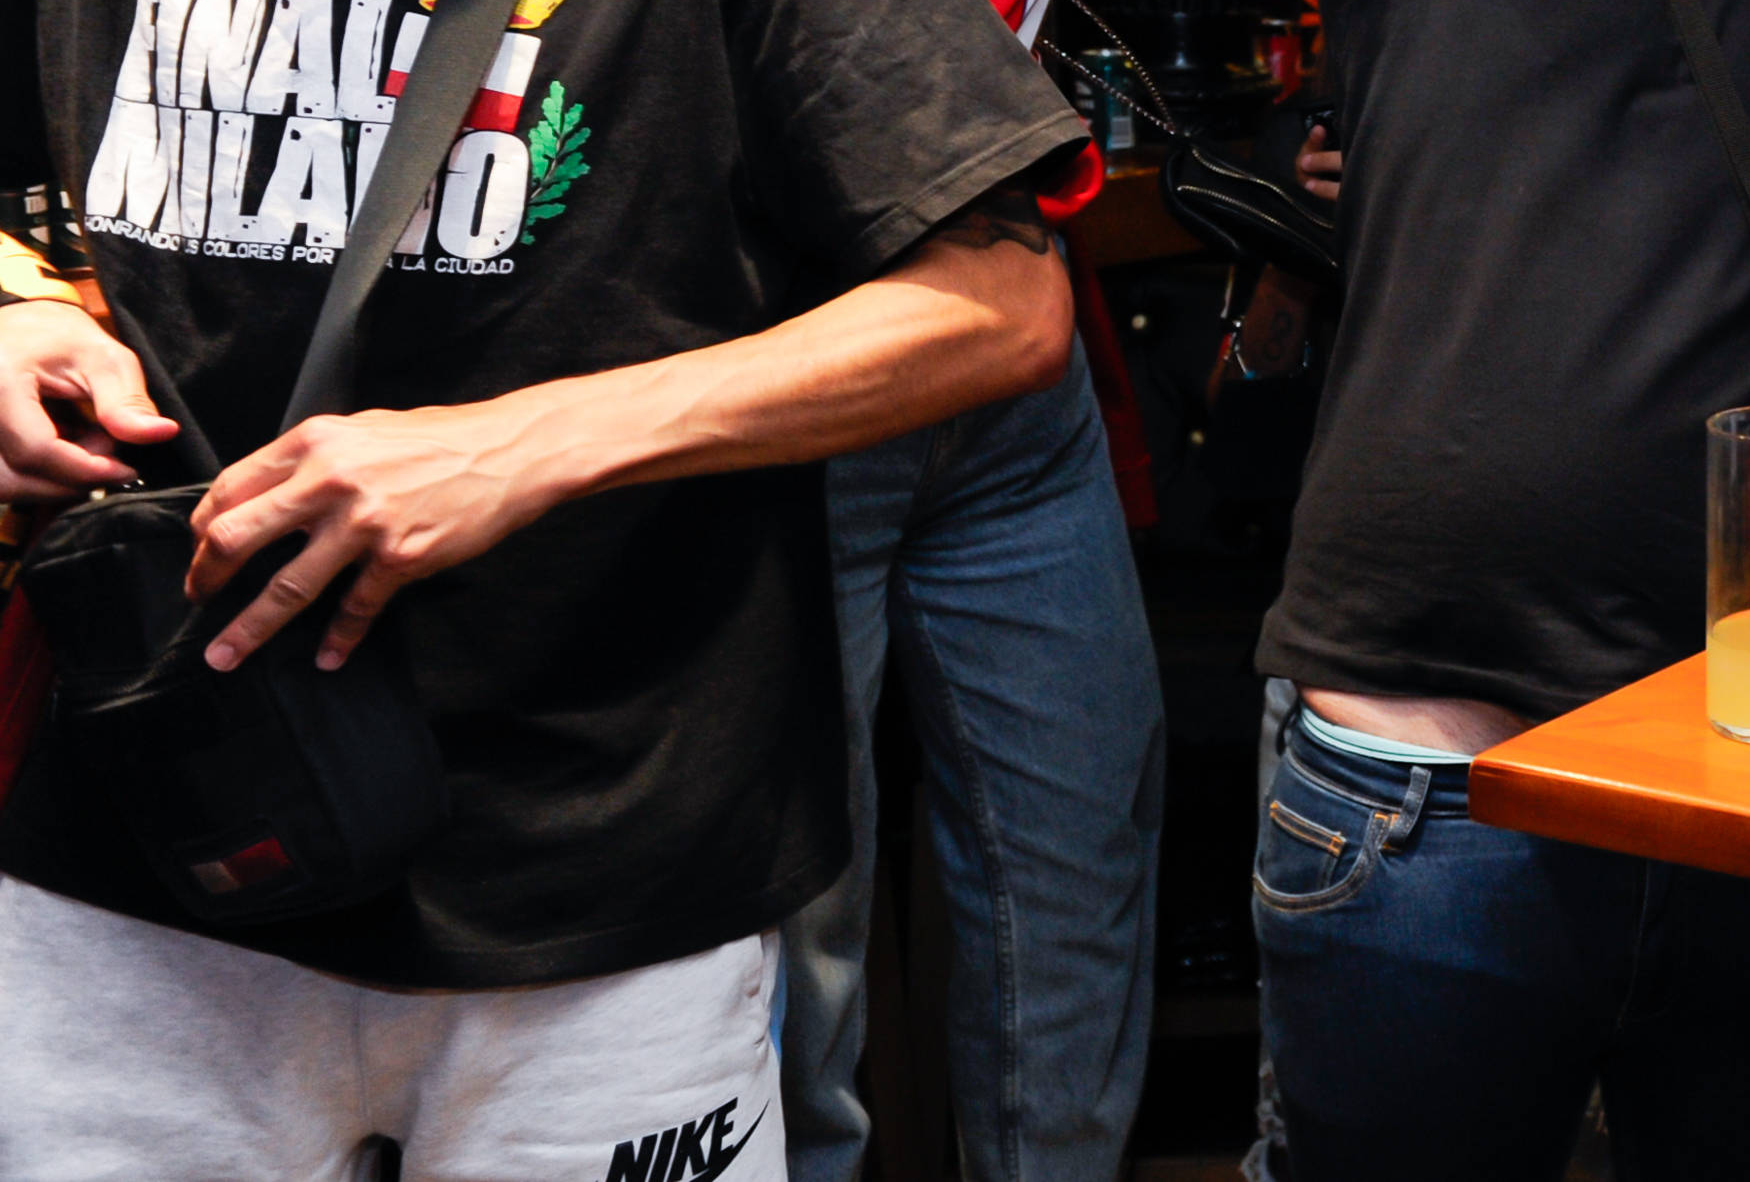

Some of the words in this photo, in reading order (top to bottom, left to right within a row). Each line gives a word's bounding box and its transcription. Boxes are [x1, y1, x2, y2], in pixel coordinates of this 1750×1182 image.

[202, 239, 287, 262] COLORES
[291, 245, 335, 265] POR
[400, 256, 427, 271] LA
[434, 257, 516, 276] CIUDAD
[604, 1096, 740, 1182] NIKE
